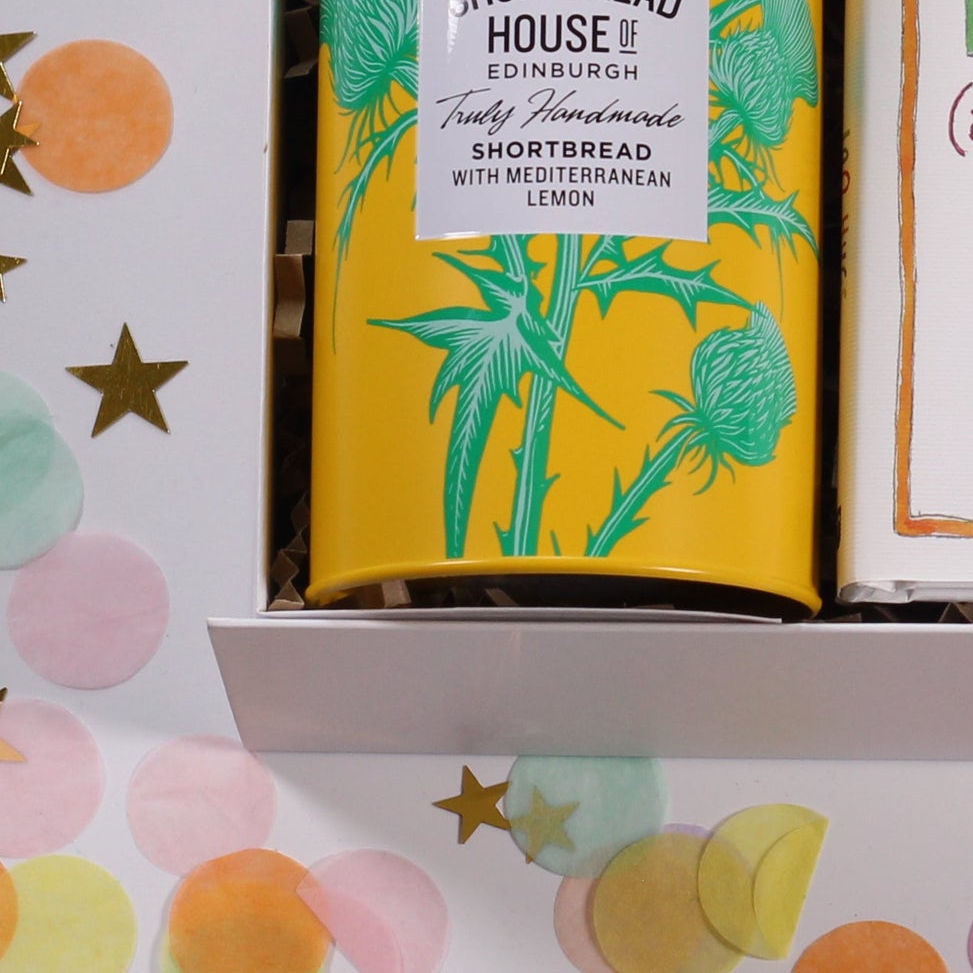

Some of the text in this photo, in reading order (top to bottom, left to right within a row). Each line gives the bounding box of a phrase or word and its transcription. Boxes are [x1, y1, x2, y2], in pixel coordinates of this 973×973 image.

[488, 14, 638, 54] HOUSE OF
[488, 63, 638, 80] EDINBURGH
[435, 88, 685, 136] Truly Handmade
[472, 141, 652, 161] SHORTBREAD
[453, 167, 671, 188] WITH MEDITERRANEAN
[527, 190, 595, 206] LEMON
